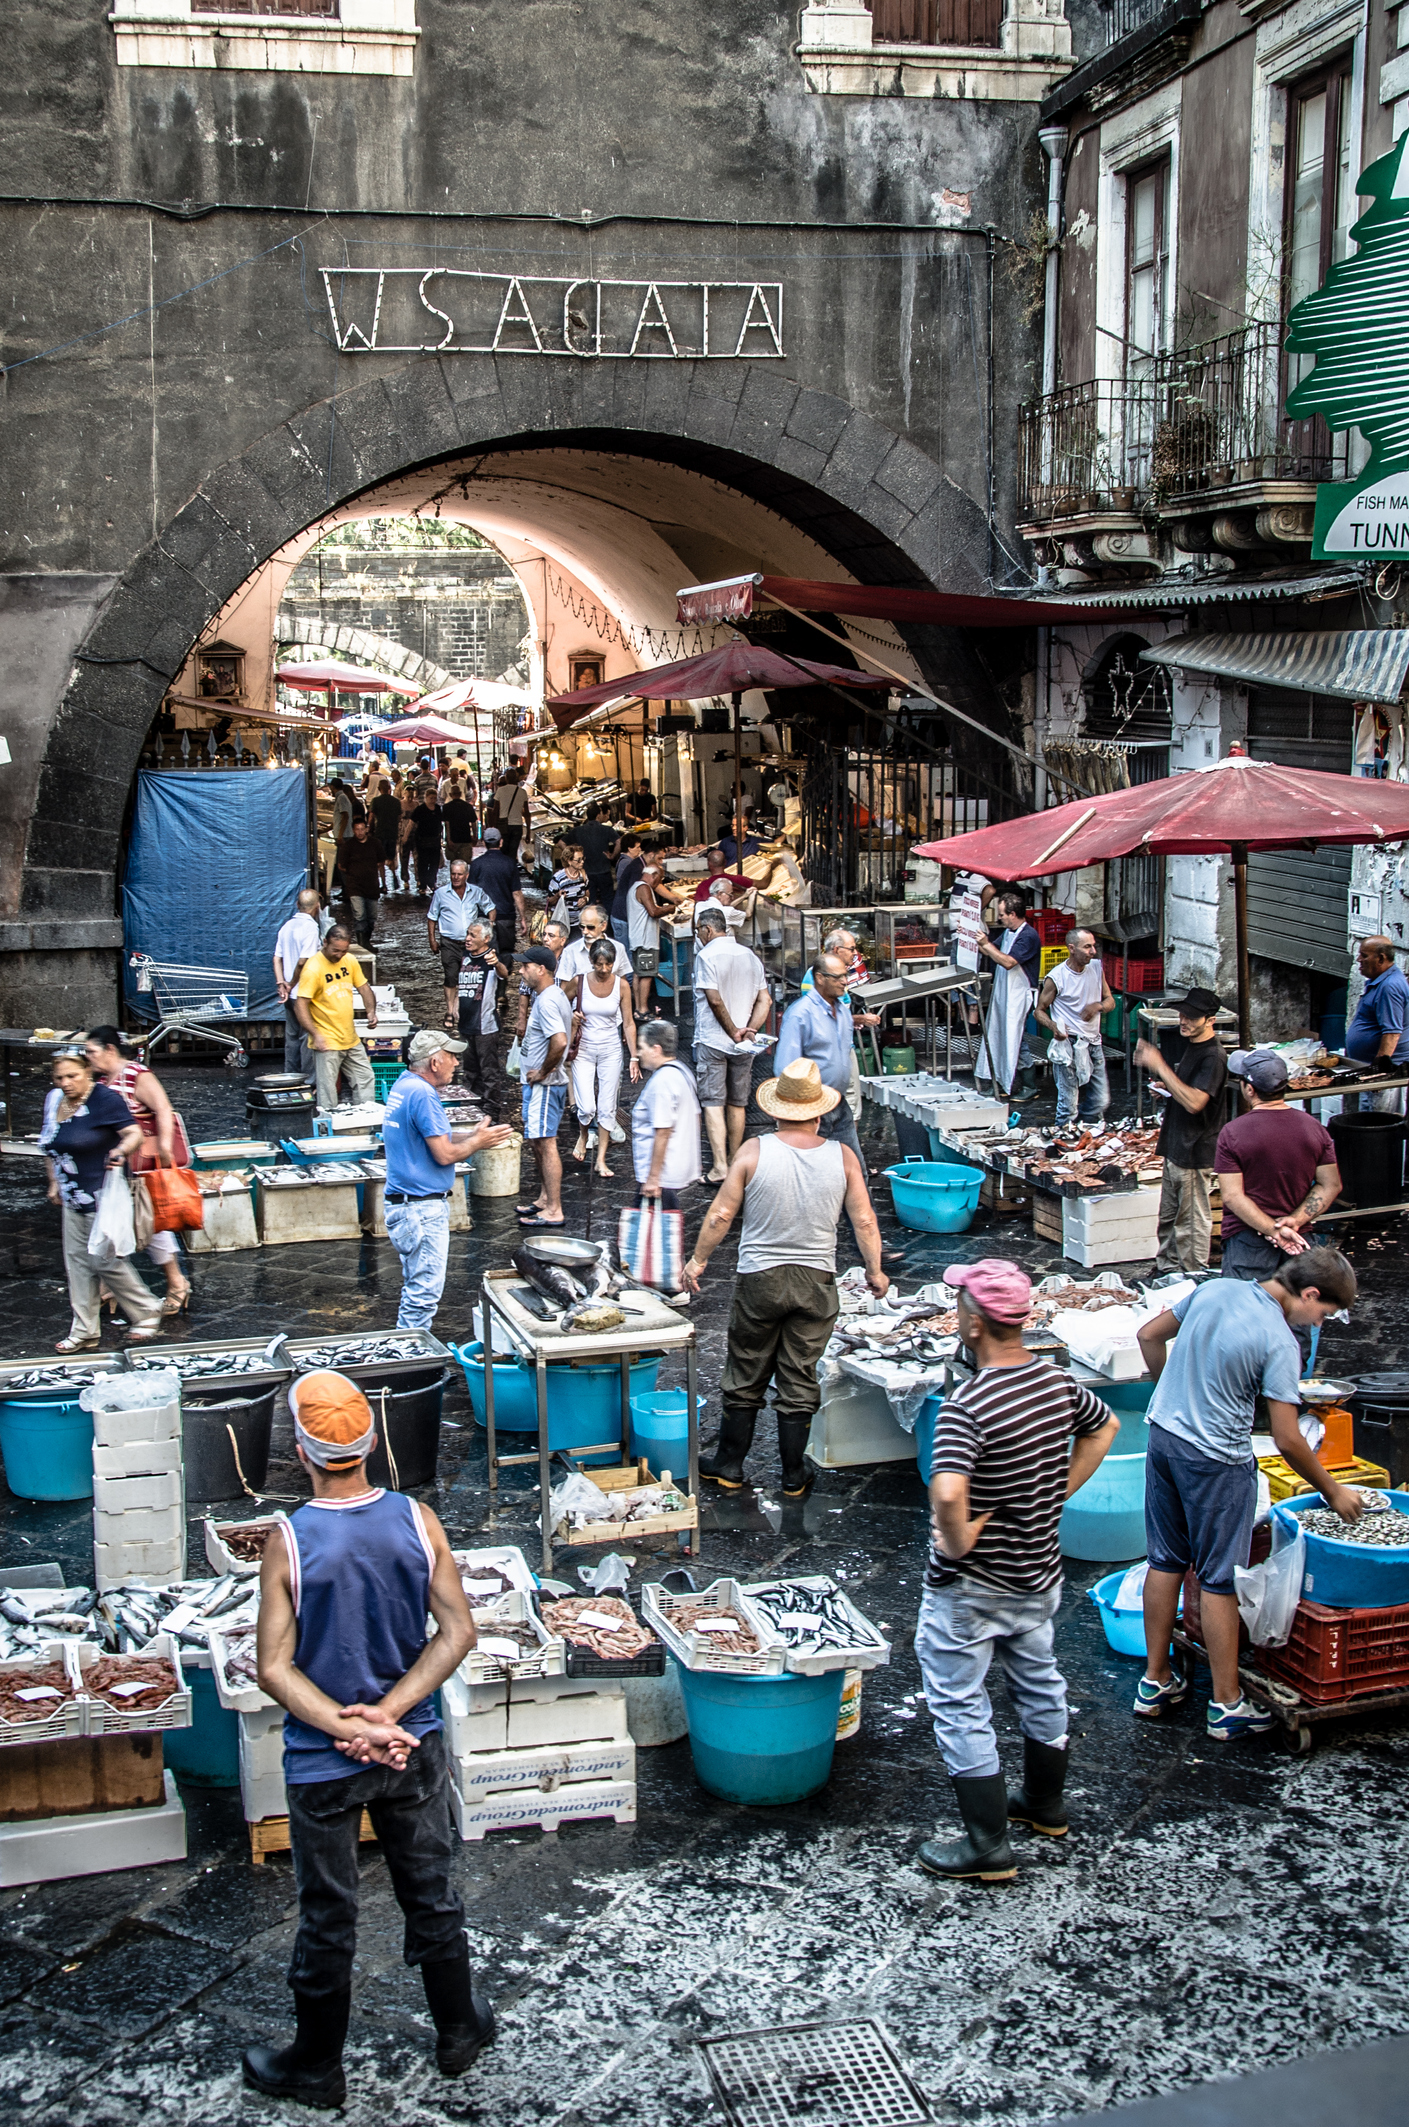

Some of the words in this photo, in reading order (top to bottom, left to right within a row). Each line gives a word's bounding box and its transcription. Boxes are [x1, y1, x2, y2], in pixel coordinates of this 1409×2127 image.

[1356, 495, 1386, 510] FISH
[1389, 495, 1409, 510] MA
[469, 1798, 629, 1823] AndromedaGroup
